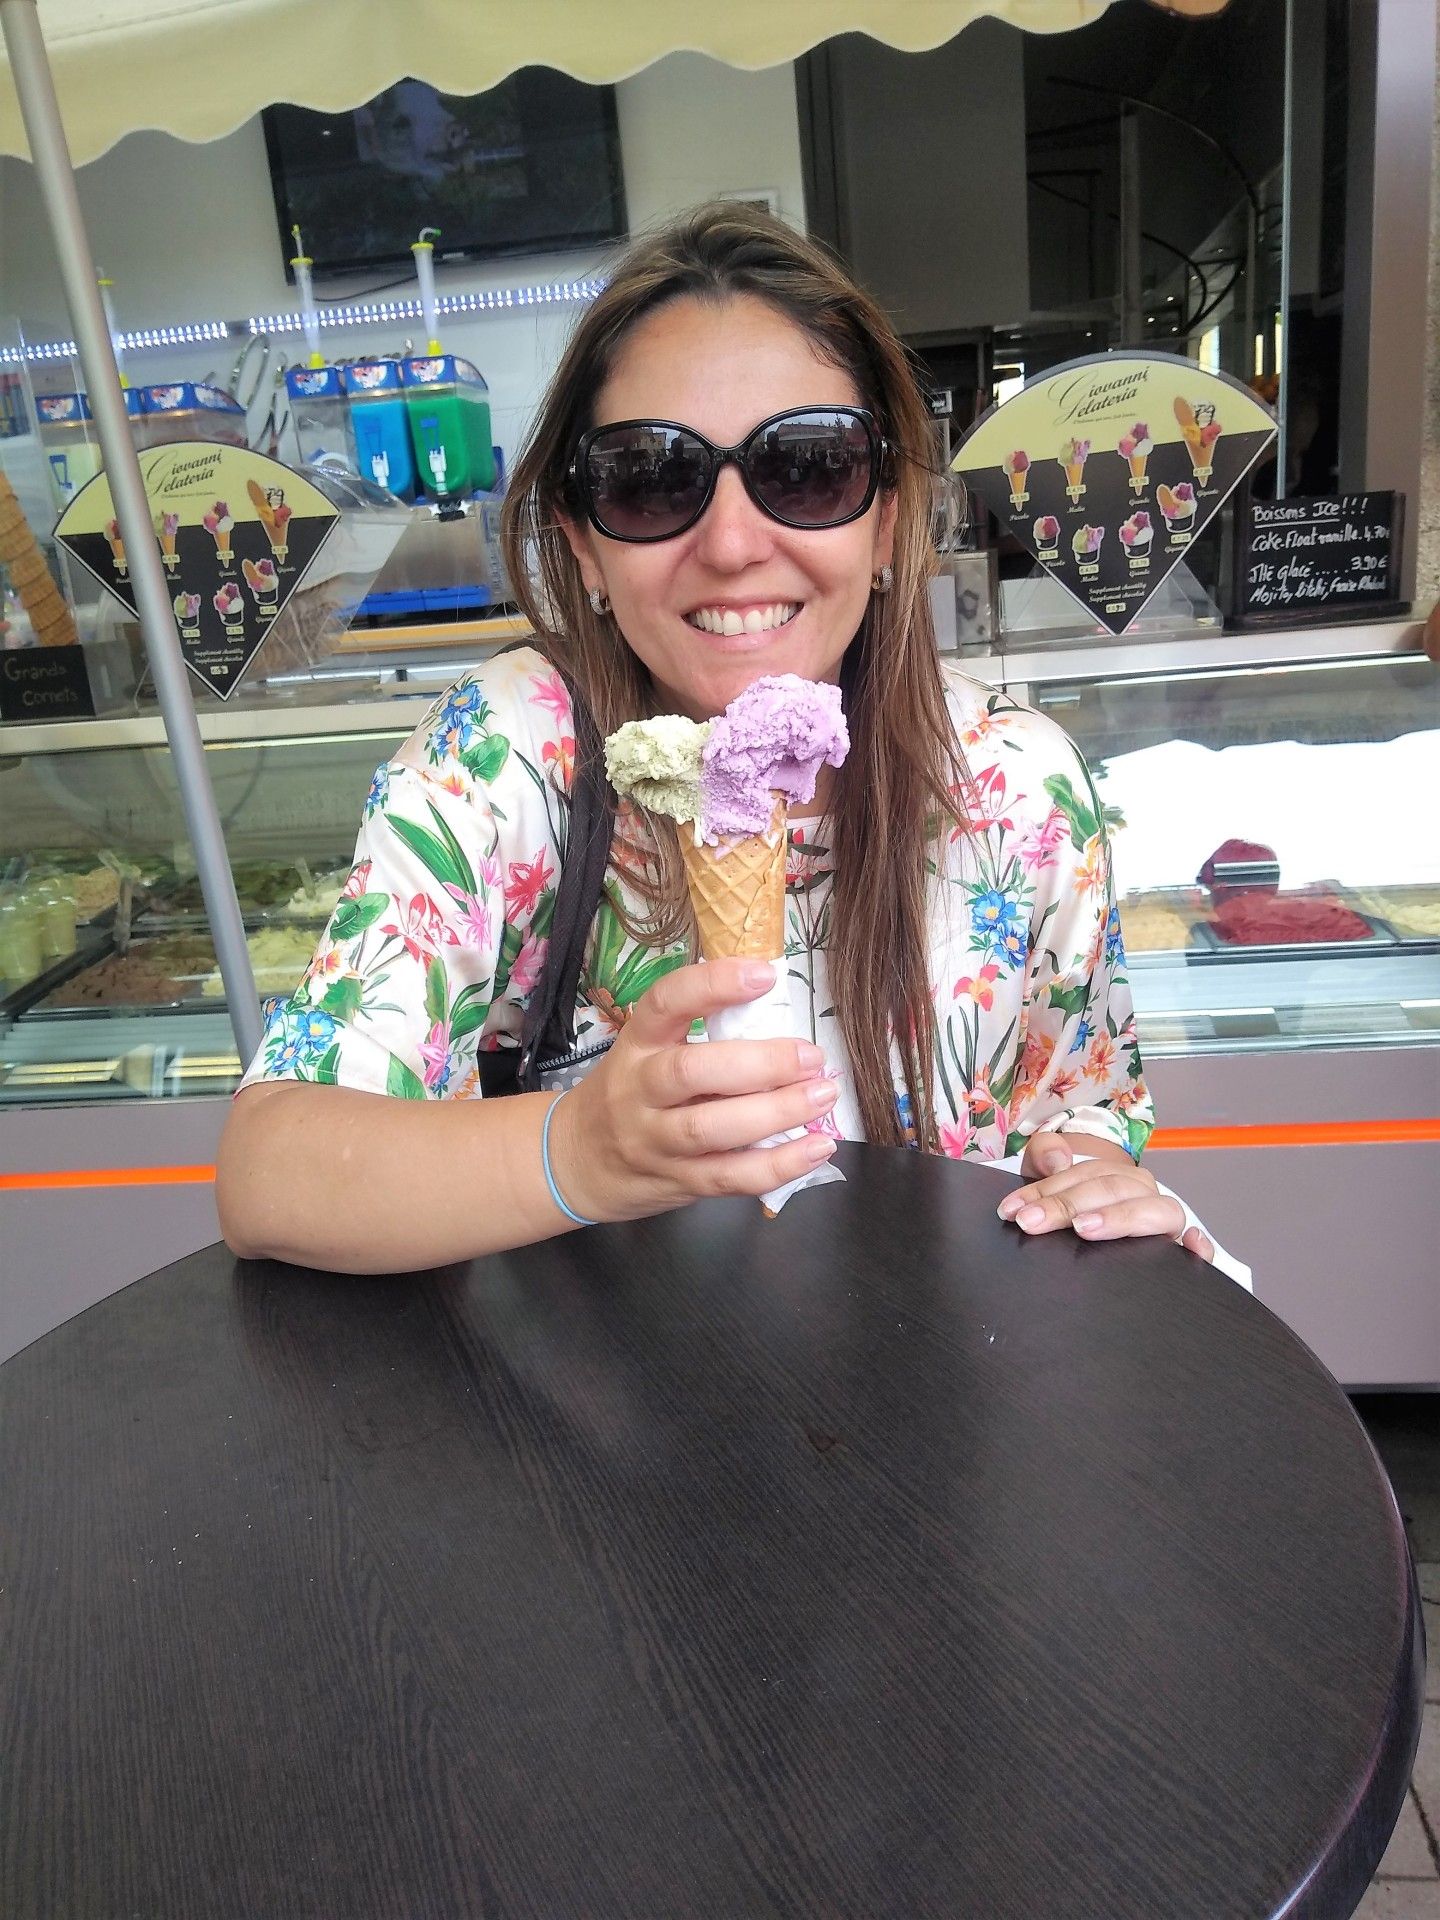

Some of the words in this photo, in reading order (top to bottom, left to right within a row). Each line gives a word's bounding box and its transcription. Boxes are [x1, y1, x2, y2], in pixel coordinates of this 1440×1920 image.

[1048, 366, 1150, 410] Giovanni
[1053, 388, 1138, 425] Gelateria
[146, 449, 222, 485] Giovanni
[150, 467, 215, 497] Gelateria
[1252, 505, 1306, 523] Boissons
